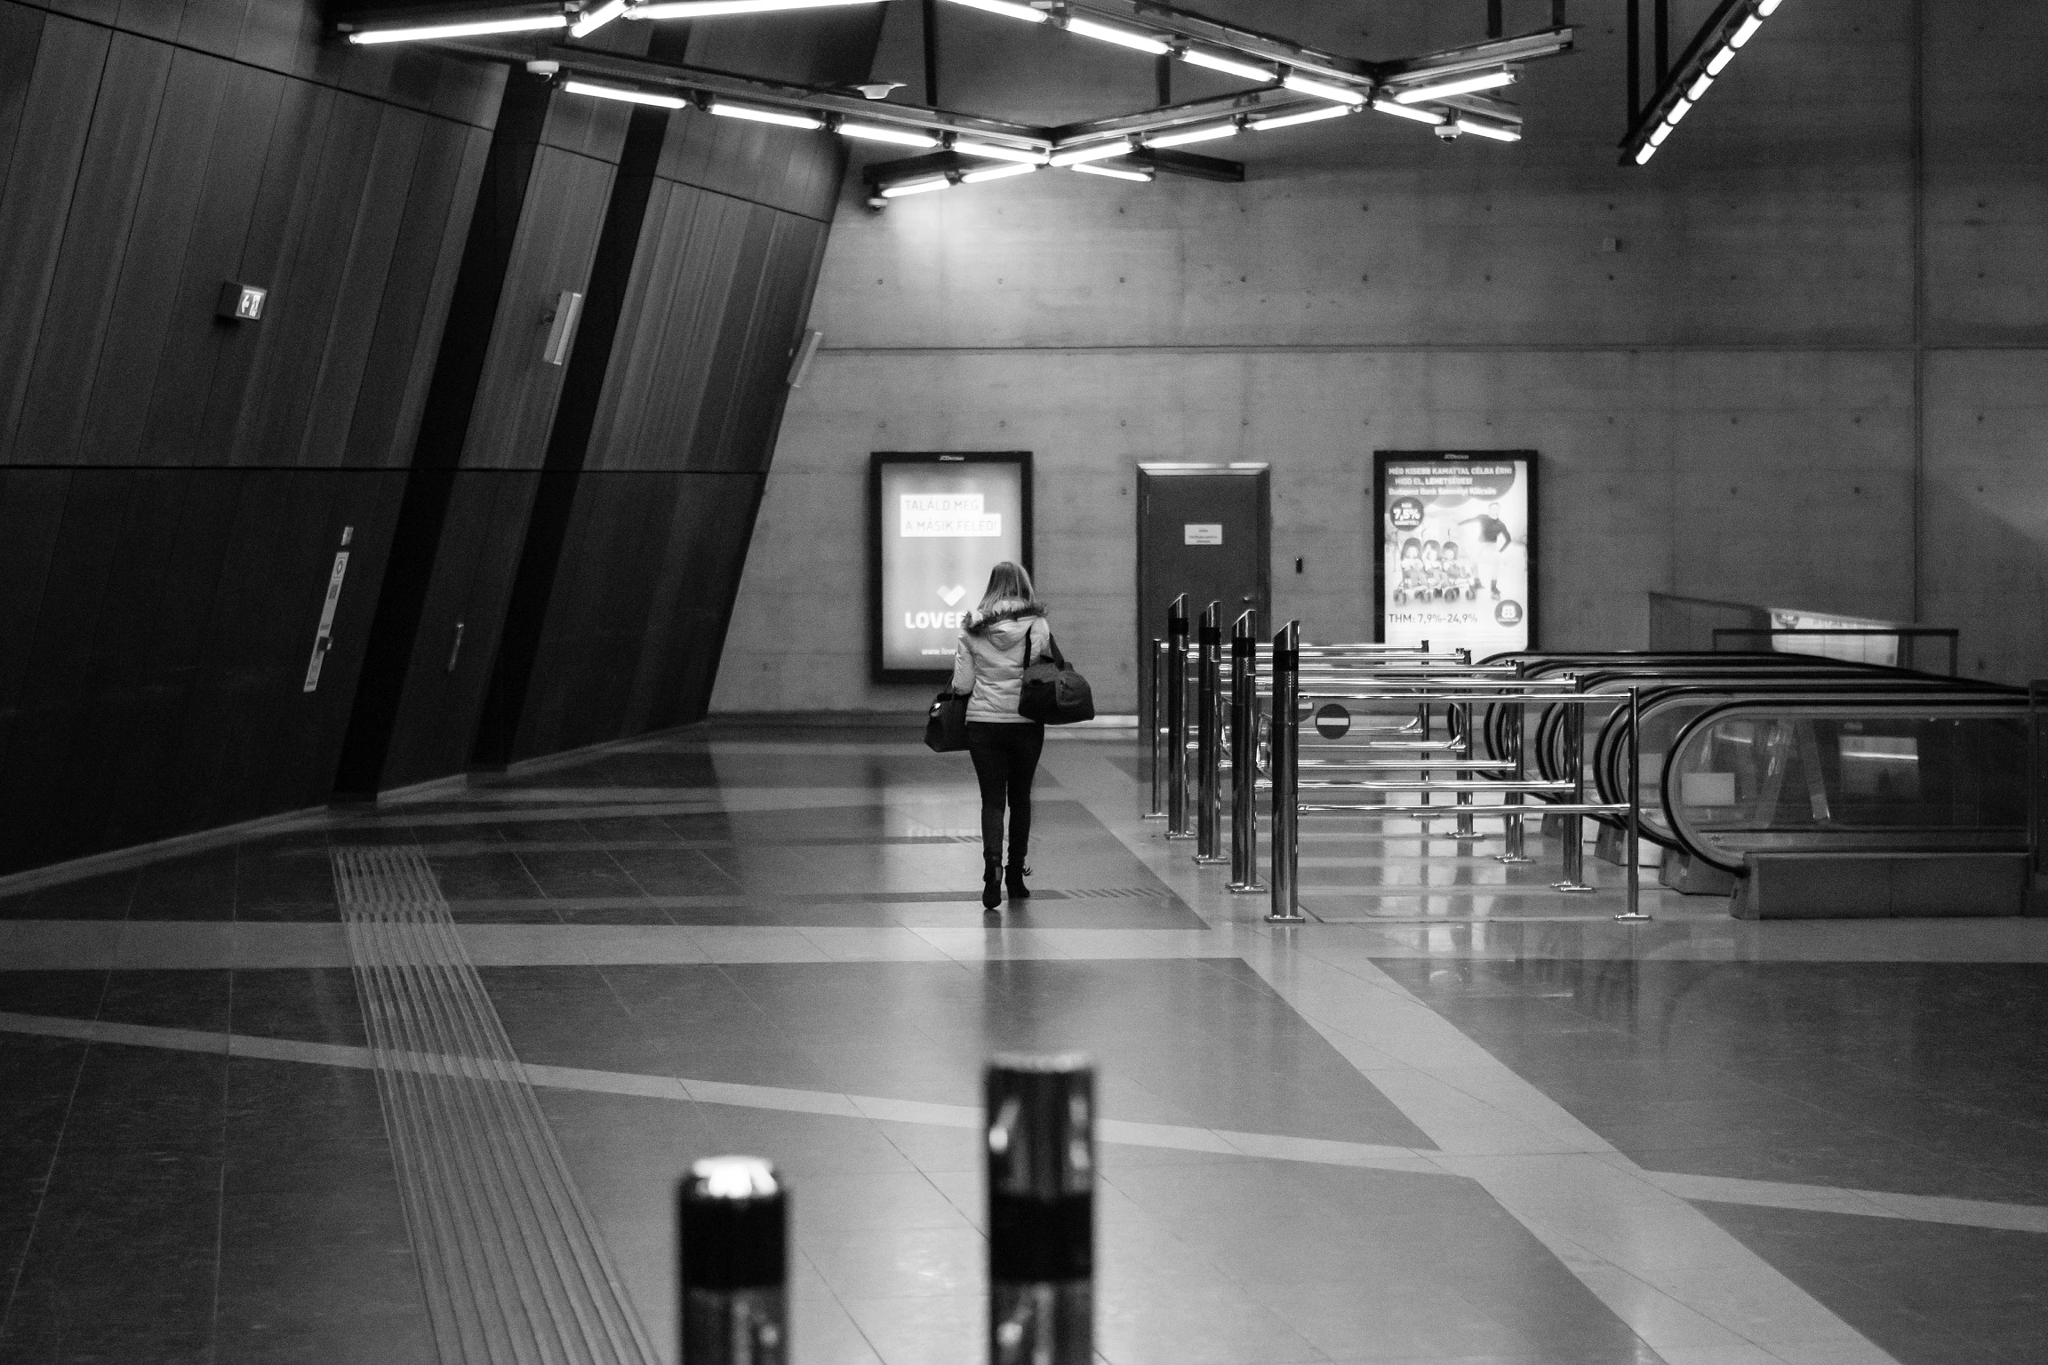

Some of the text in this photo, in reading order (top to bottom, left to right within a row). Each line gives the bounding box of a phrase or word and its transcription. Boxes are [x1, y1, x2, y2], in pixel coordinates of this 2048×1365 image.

[904, 497, 979, 511] TALÁLD MEG
[1393, 508, 1420, 521] 7,5%
[904, 520, 912, 531] A
[1388, 613, 1415, 623] THM:
